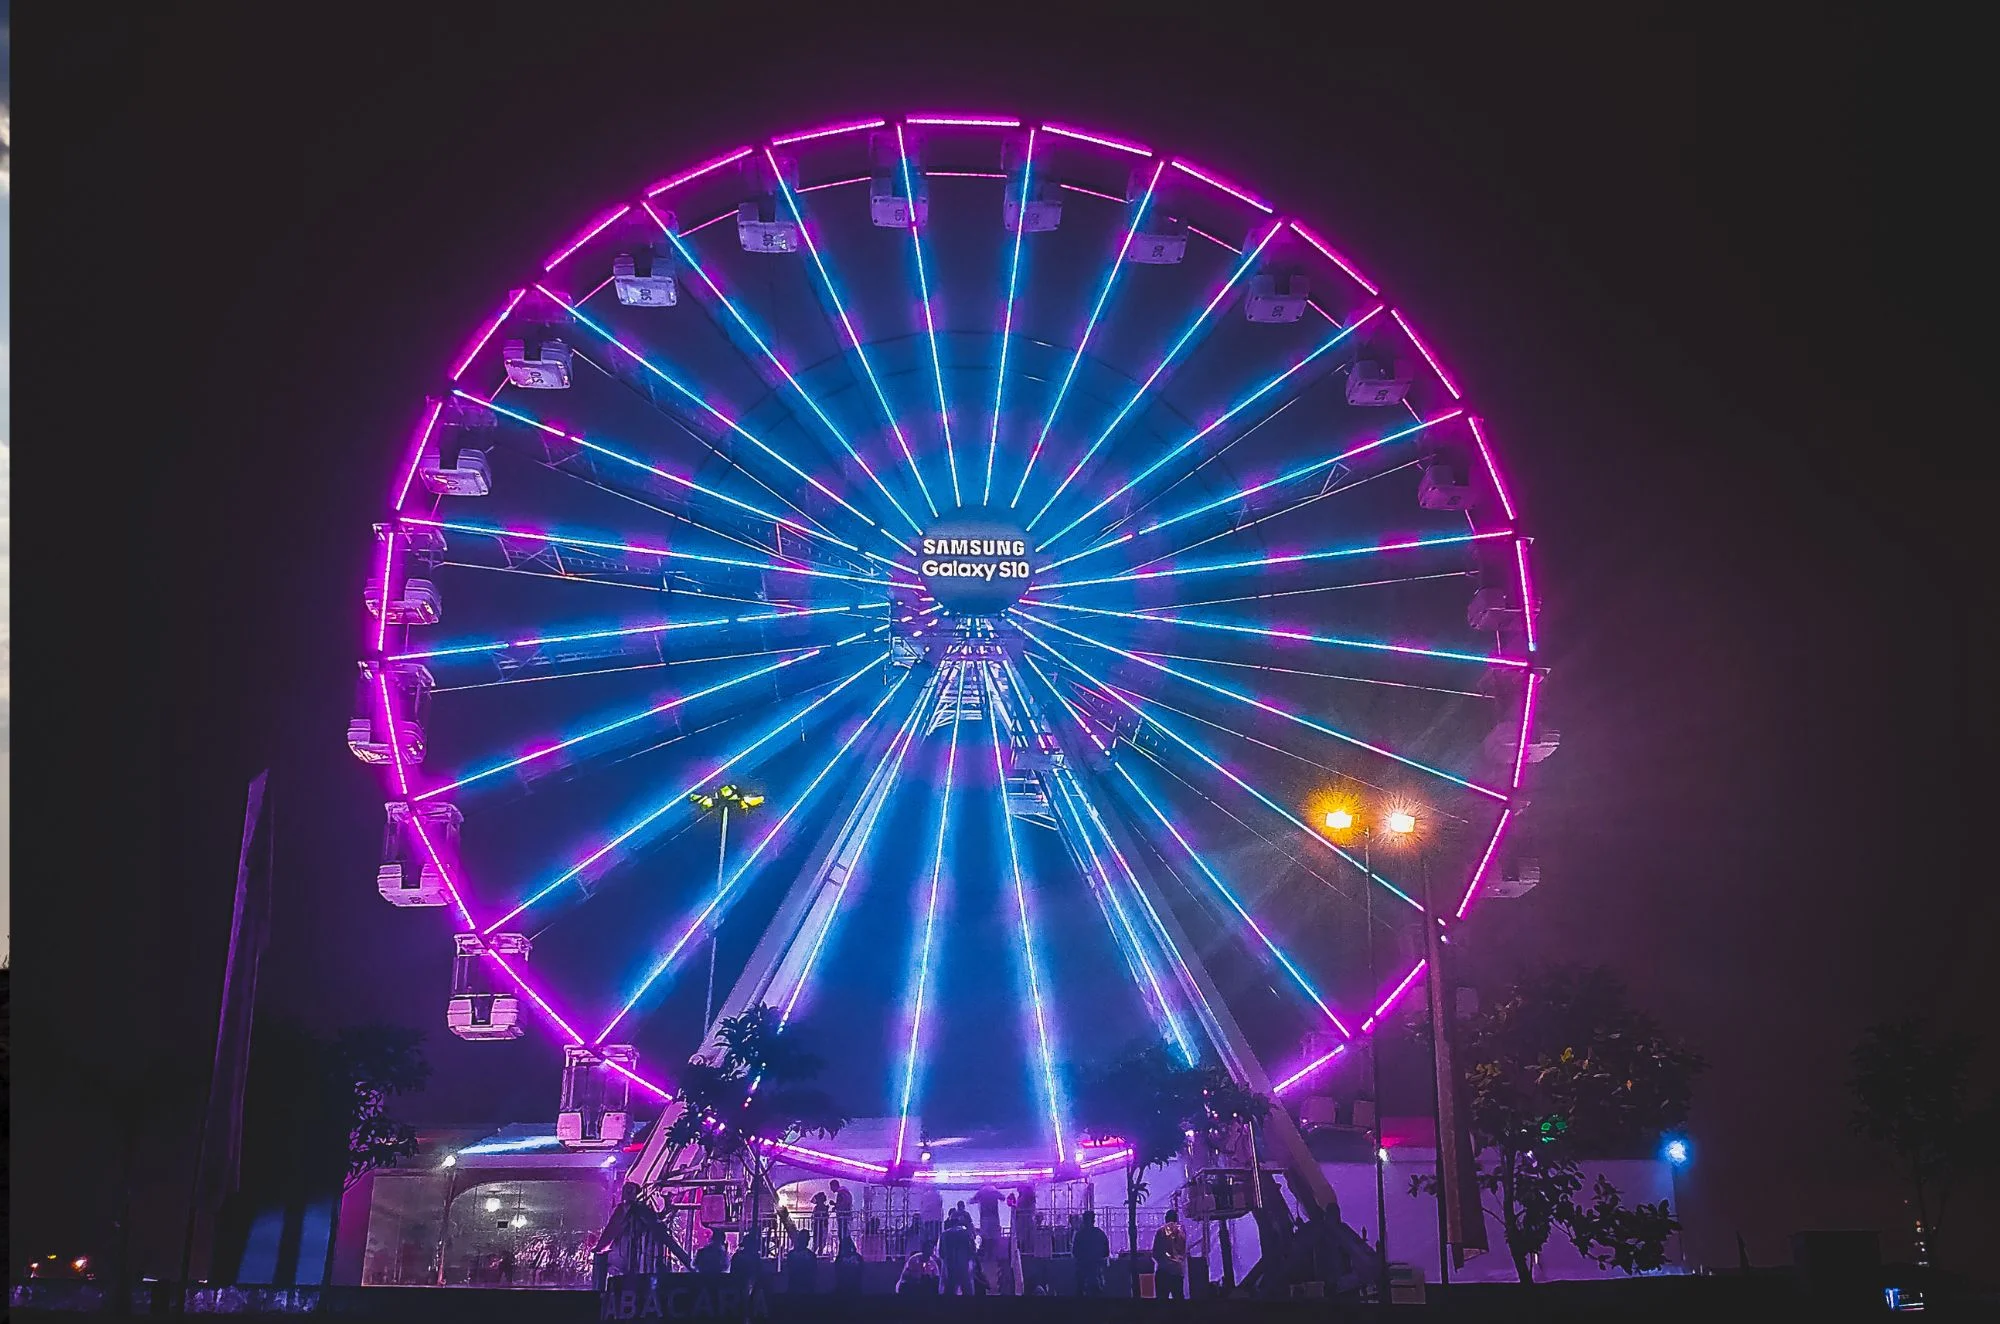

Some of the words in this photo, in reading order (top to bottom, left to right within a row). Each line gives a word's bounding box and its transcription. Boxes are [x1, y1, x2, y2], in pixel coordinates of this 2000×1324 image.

[923, 538, 1025, 557] SAMSUNG
[921, 559, 996, 581] Galaxy
[998, 561, 1030, 578] S10
